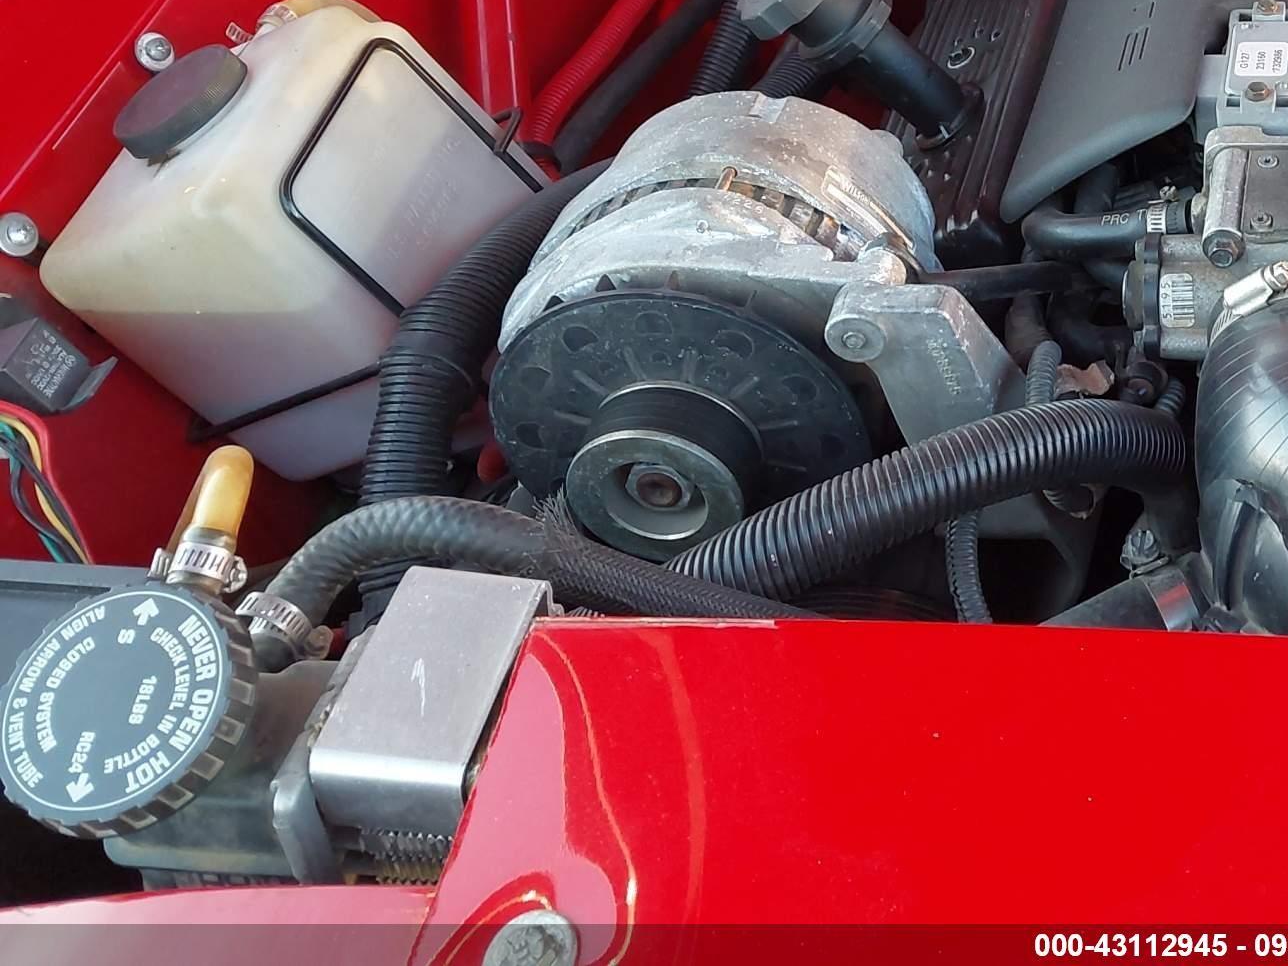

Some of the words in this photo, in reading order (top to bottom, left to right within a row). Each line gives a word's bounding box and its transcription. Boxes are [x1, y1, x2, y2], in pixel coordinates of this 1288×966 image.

[1100, 212, 1130, 227] PRC
[1160, 280, 1172, 322] 5195
[60, 605, 107, 642] ALIGN
[19, 637, 62, 693] ARROW
[45, 636, 96, 689] CLOSED
[150, 627, 188, 669] CHECK
[178, 615, 218, 682] NEVER
[128, 675, 158, 725] 18LBS
[168, 664, 190, 711] LEVEL
[8, 711, 25, 752] VENT
[34, 691, 58, 753] SYSTEM
[157, 714, 177, 735] IN
[168, 689, 214, 752] OPEN
[13, 754, 45, 789] TUBE
[68, 731, 97, 774] RC24
[103, 734, 161, 774] BOTTLE
[125, 750, 171, 794] HOT
